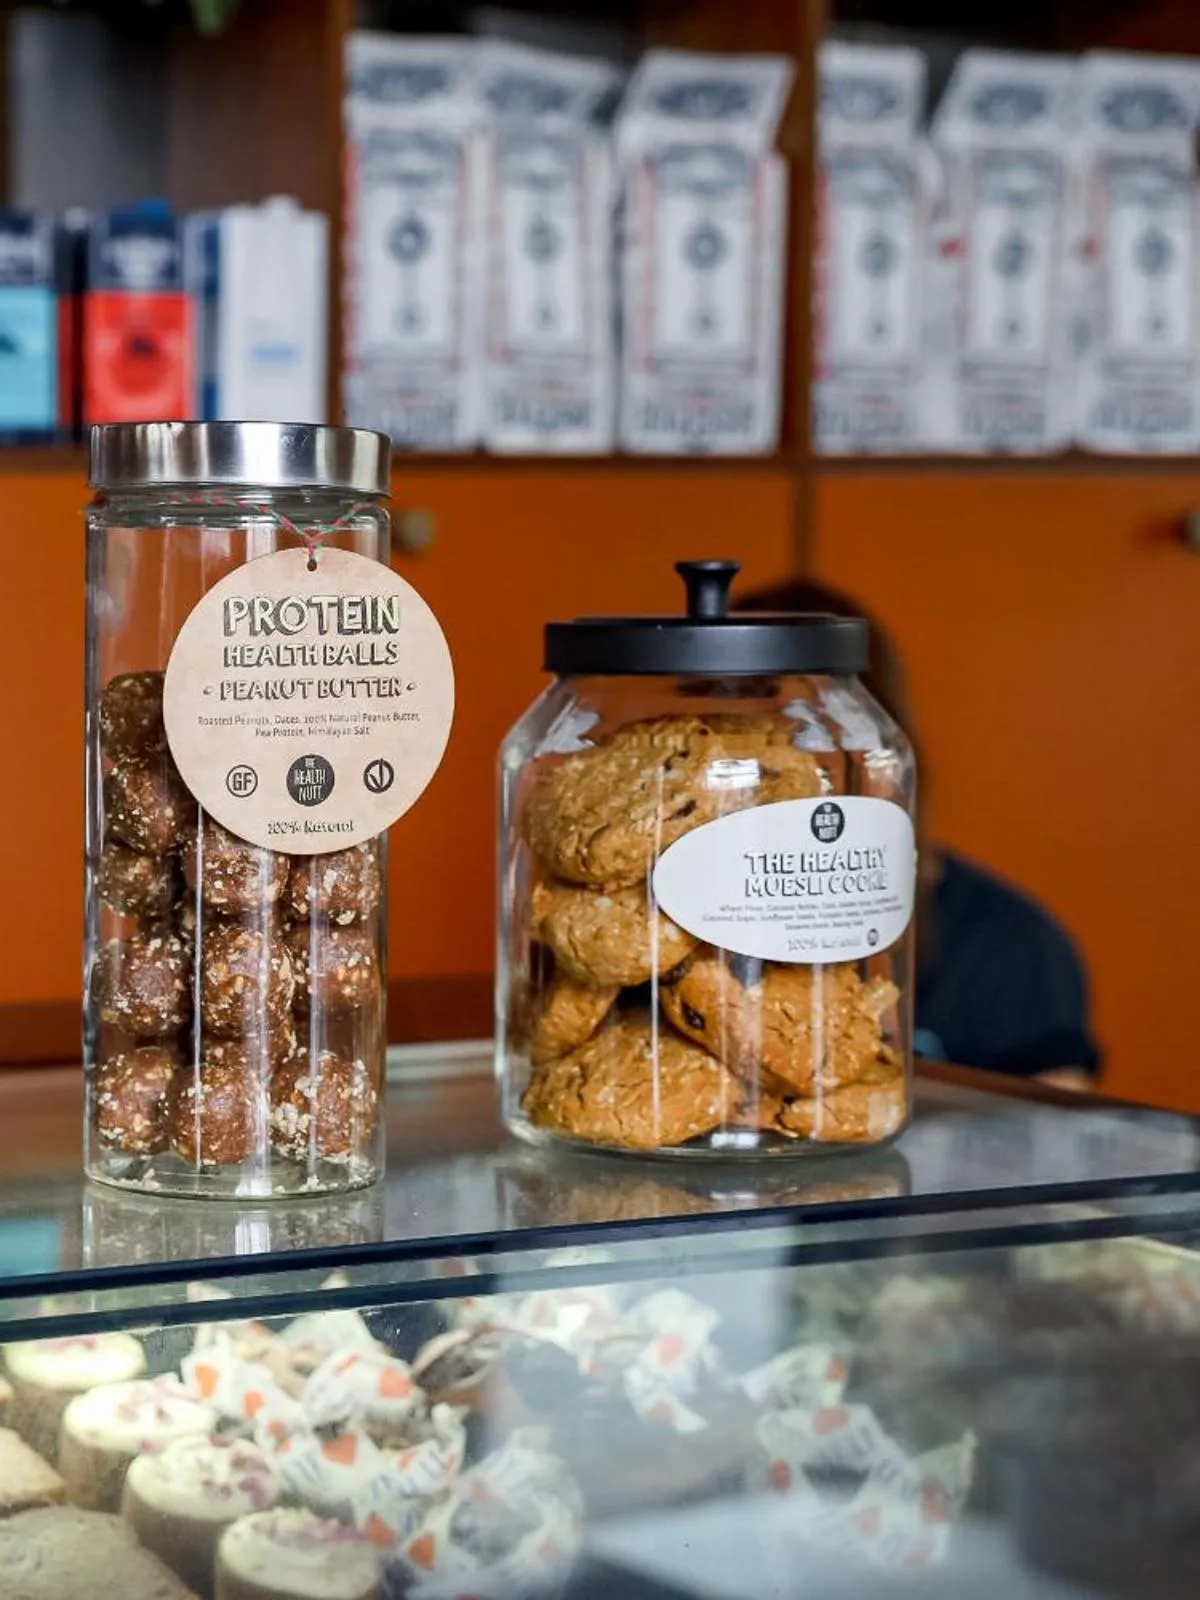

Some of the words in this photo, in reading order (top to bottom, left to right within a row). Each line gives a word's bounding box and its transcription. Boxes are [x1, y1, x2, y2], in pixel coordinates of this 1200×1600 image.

[224, 595, 399, 637] PROTEIN
[224, 643, 318, 668] HEALTH
[323, 641, 400, 666] BALLS
[220, 677, 314, 701] PEANUT
[318, 676, 402, 699] BUTTER
[232, 772, 252, 791] GF
[294, 768, 326, 785] HEALTH
[303, 820, 354, 834] Natural
[744, 852, 795, 875] THE
[800, 846, 887, 873] HEALTHY
